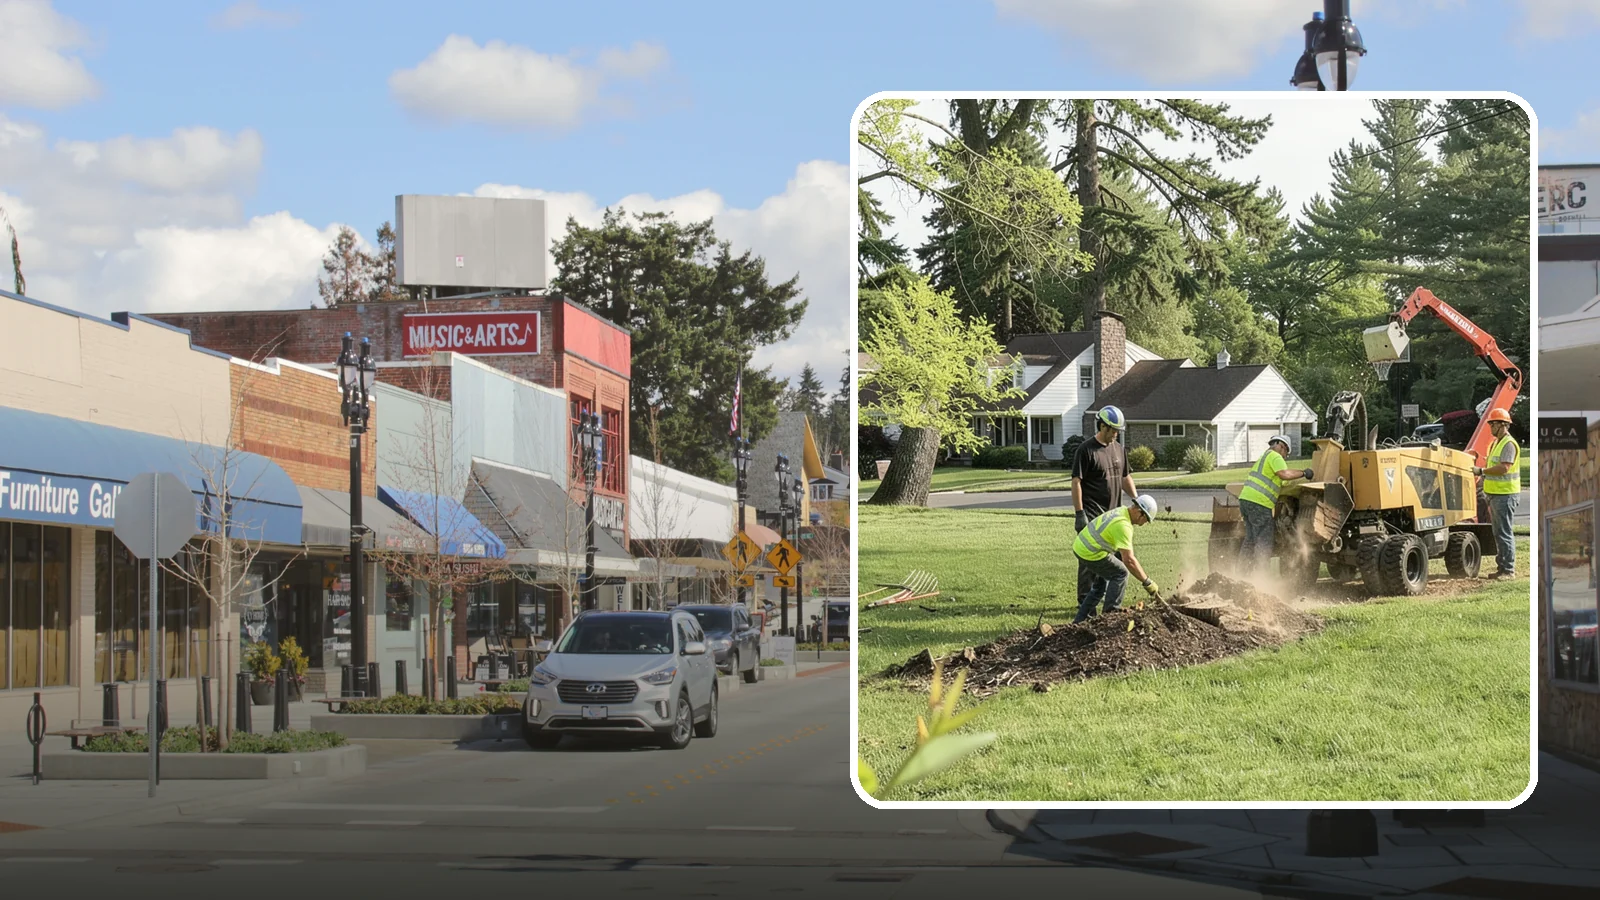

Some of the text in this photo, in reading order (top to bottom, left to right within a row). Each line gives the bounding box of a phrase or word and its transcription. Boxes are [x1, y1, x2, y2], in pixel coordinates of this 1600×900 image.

[0, 471, 122, 519] Furniture Gal
[452, 563, 480, 574] SUSHI
